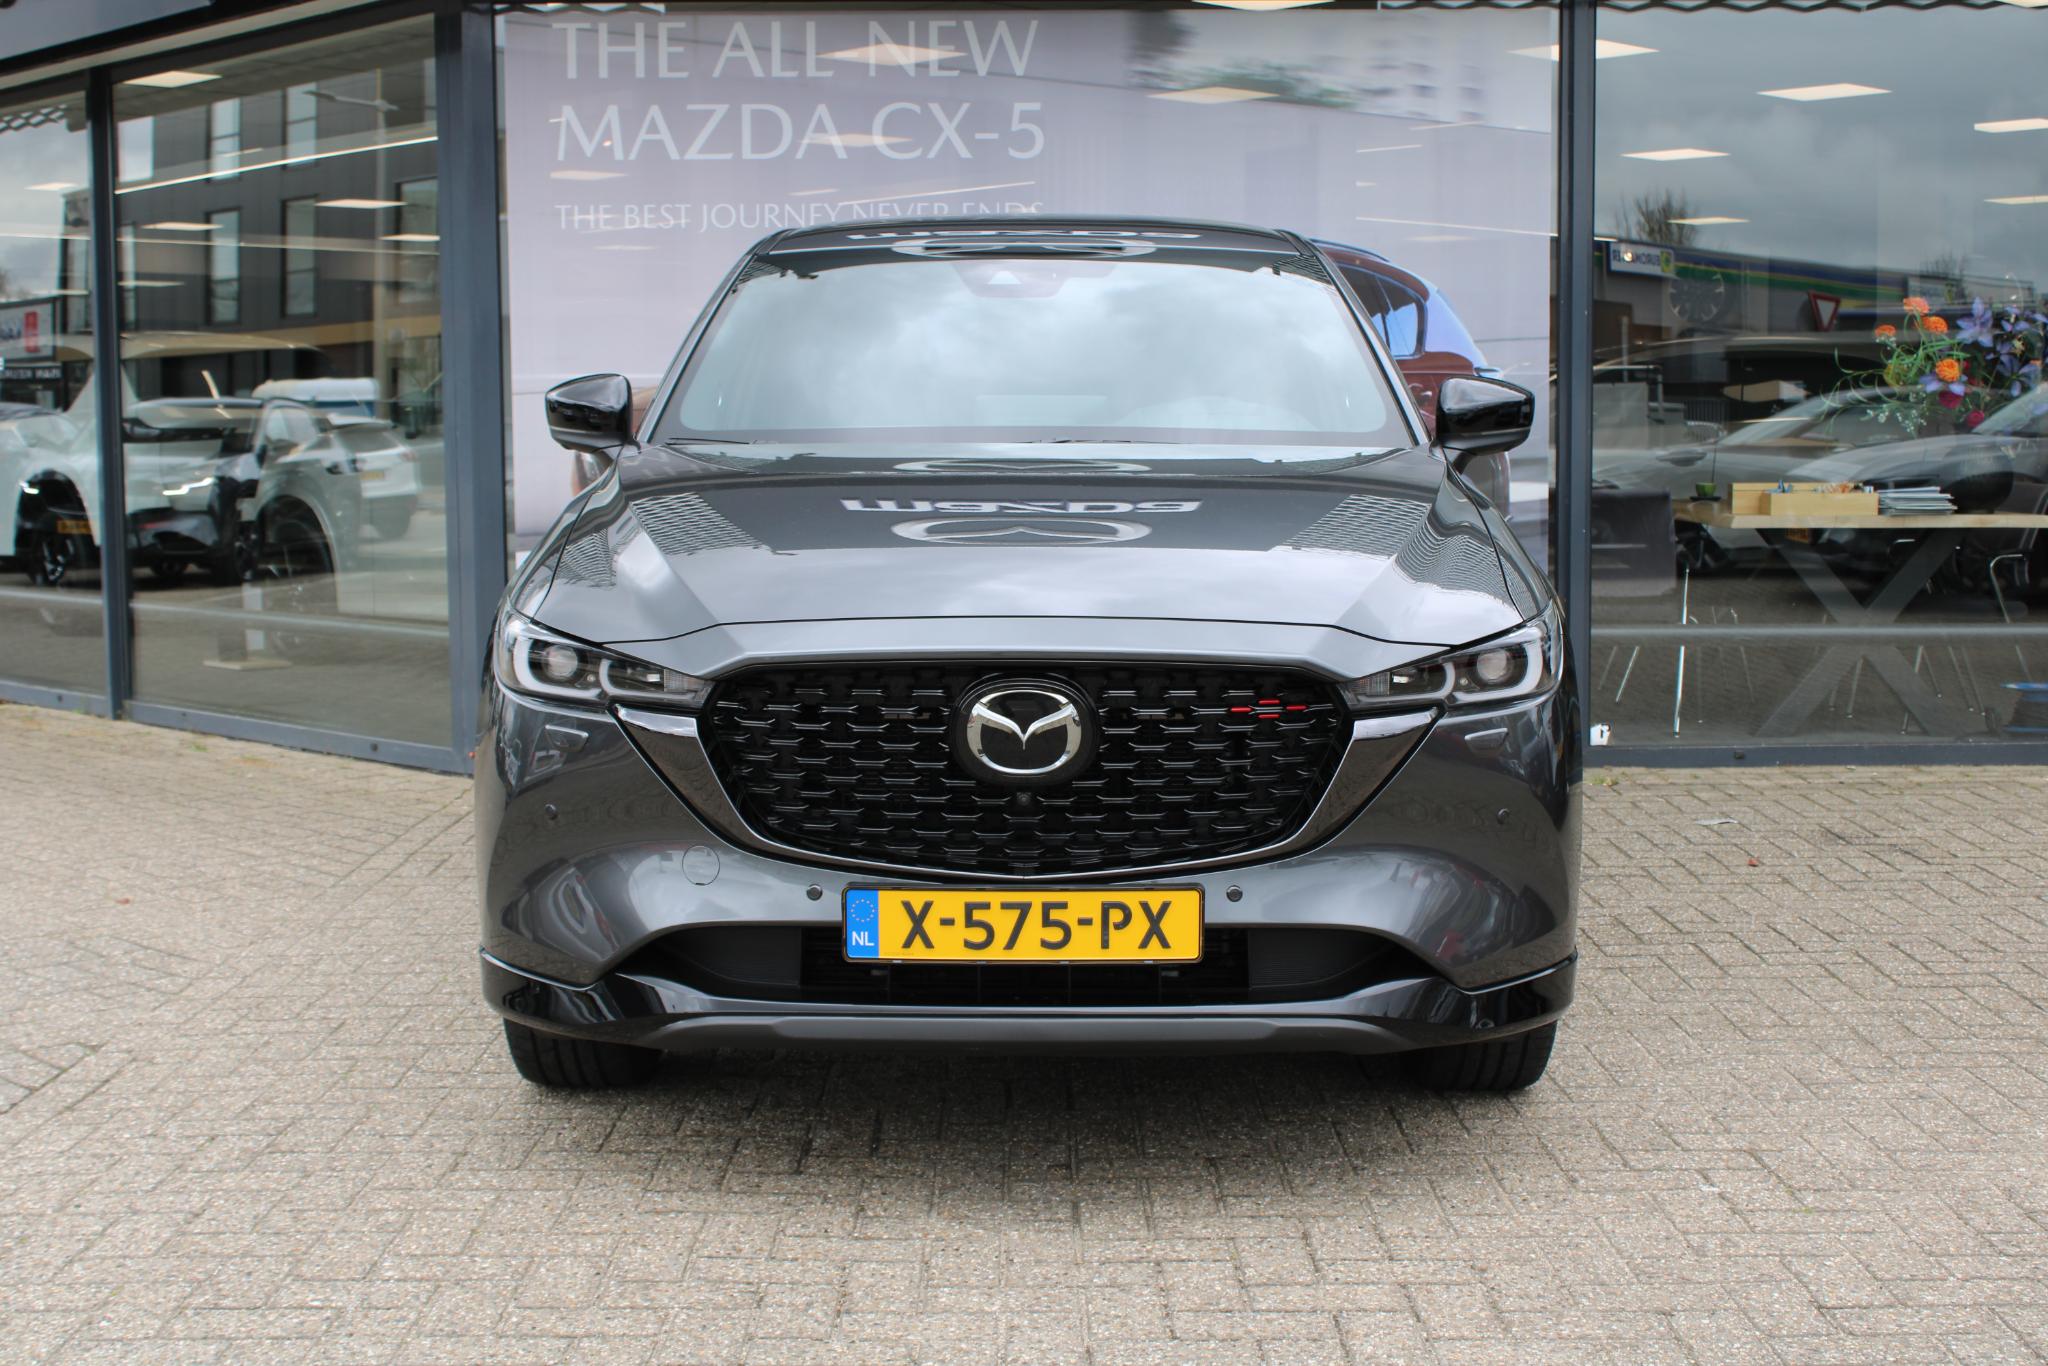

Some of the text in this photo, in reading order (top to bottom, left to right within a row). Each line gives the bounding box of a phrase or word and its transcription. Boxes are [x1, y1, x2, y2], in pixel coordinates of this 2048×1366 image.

[551, 19, 1040, 80] THE ALL NEW
[555, 101, 1046, 161] MAZDA CX-5
[553, 203, 613, 231] THE
[623, 203, 692, 230] BEST
[851, 900, 1172, 951] NL X-575-PX
